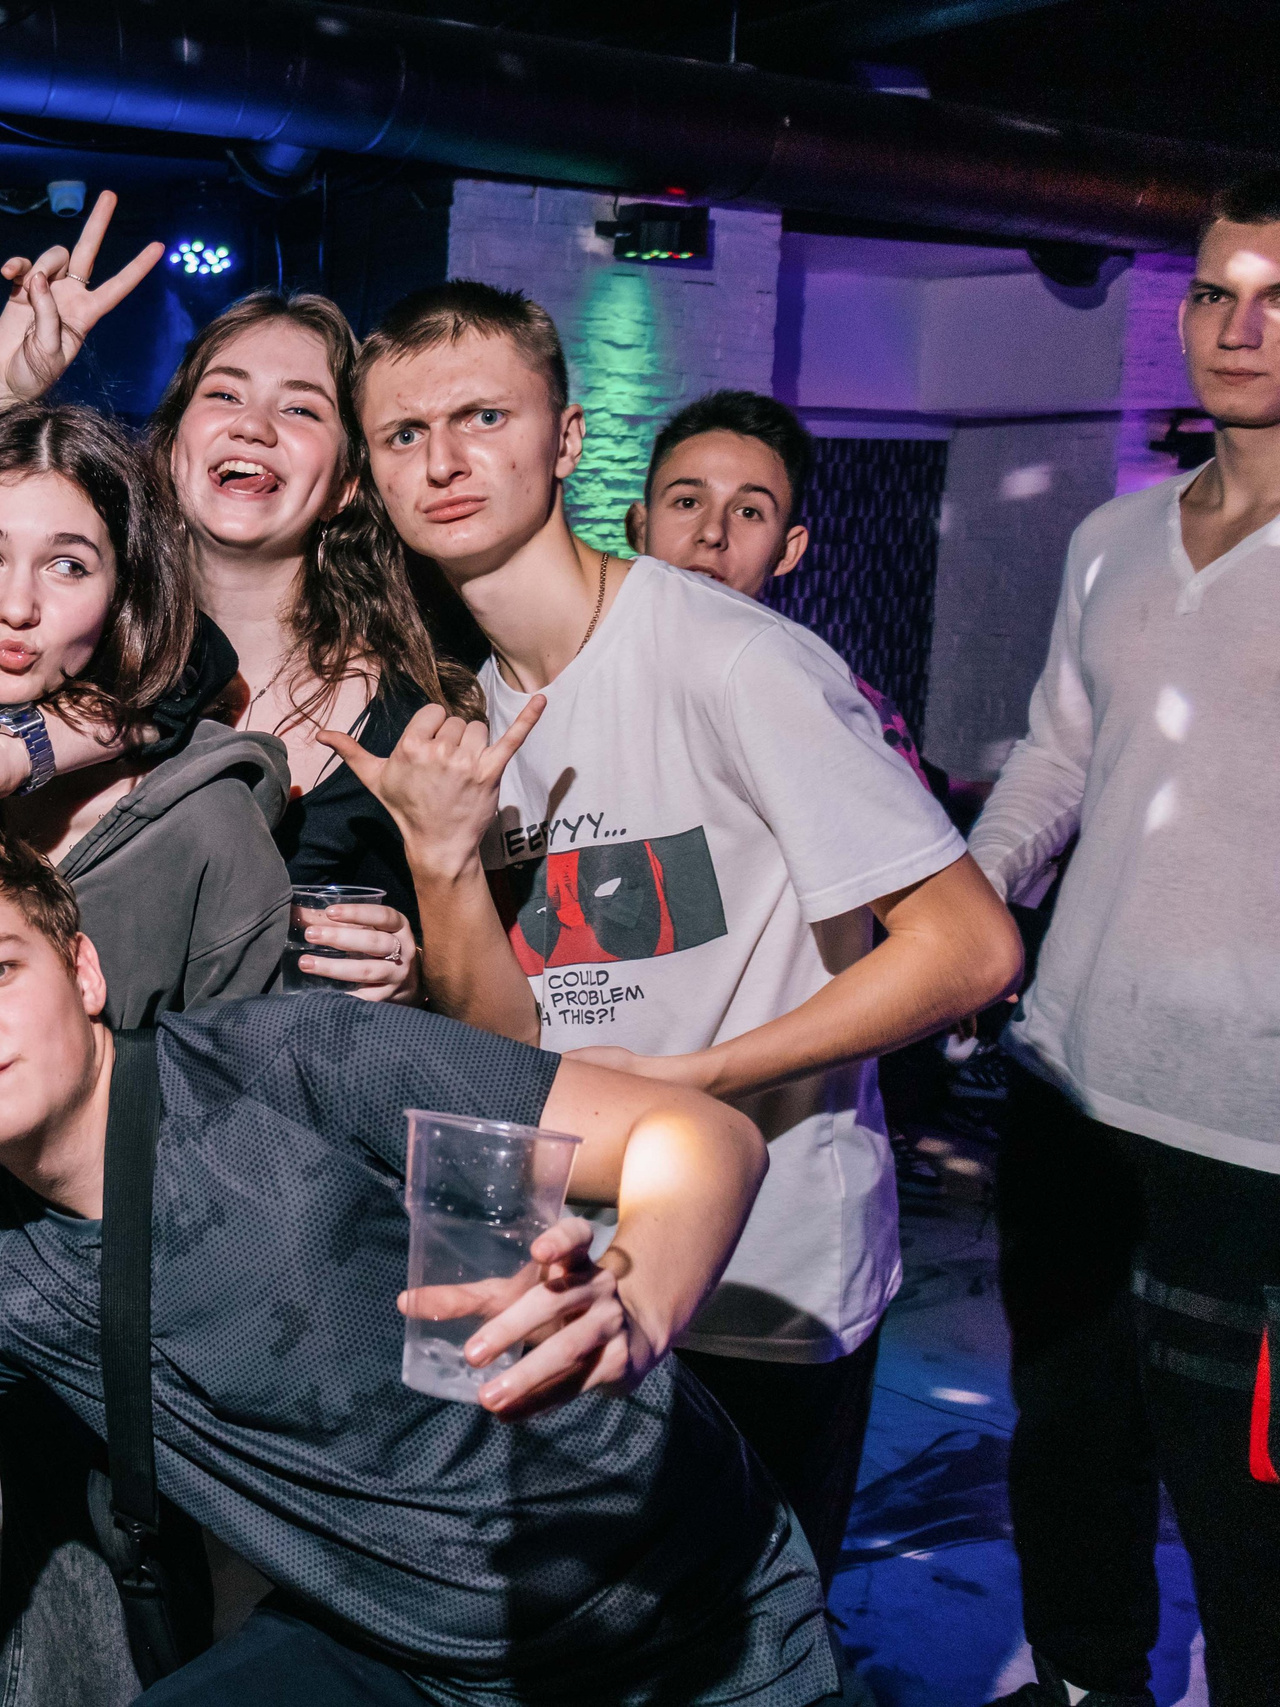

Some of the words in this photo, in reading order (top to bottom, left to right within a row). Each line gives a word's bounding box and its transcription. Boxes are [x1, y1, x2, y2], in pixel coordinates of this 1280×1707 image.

[548, 969, 610, 990] COULD
[550, 984, 645, 1008] PROBLEM
[558, 1006, 616, 1025] THIS?!
